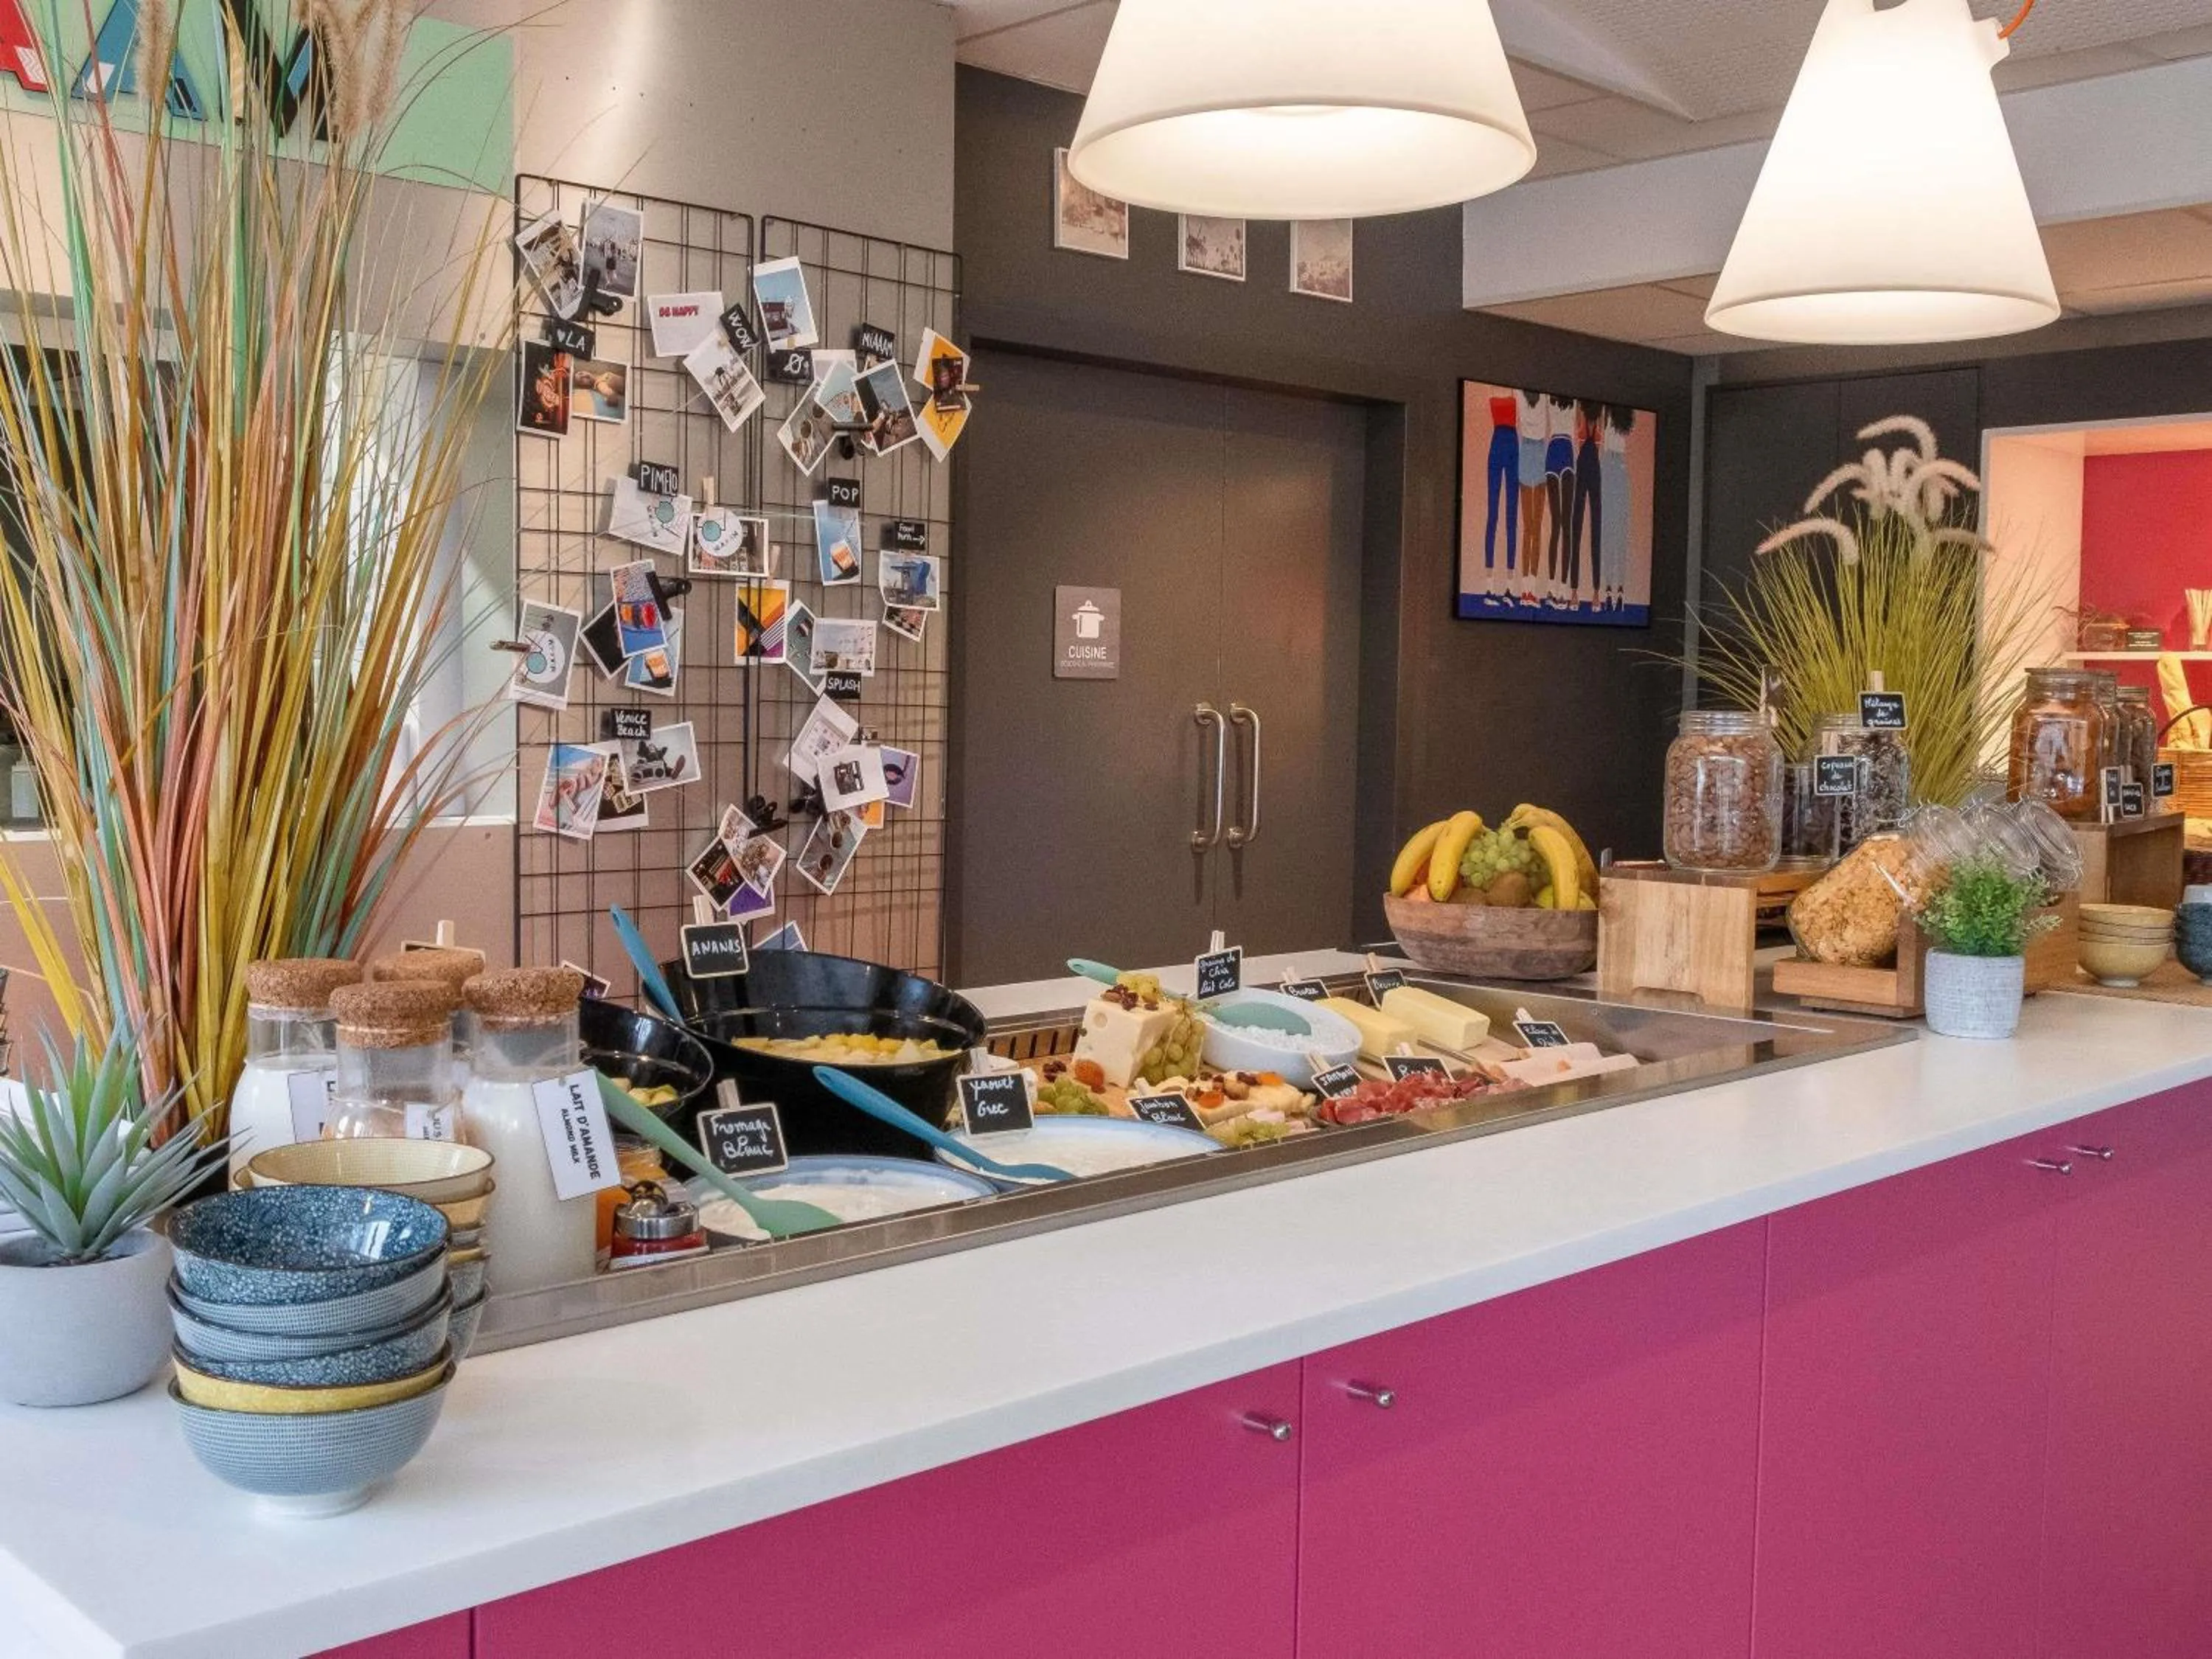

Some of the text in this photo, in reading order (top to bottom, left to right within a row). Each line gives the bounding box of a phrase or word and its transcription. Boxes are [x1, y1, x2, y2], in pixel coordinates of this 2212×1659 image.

[566, 330, 585, 352] LA
[832, 485, 859, 502] POP
[1069, 646, 1107, 659] CUISINE
[827, 677, 860, 693] SPLASH
[692, 939, 741, 956] ANANAS
[977, 1100, 1009, 1117] Grec
[561, 1108, 581, 1164] ALMOND MILK
[569, 1084, 601, 1180] LAIT D'AMANDE
[711, 1114, 771, 1142] Fromage
[723, 1135, 773, 1158] Blanc
